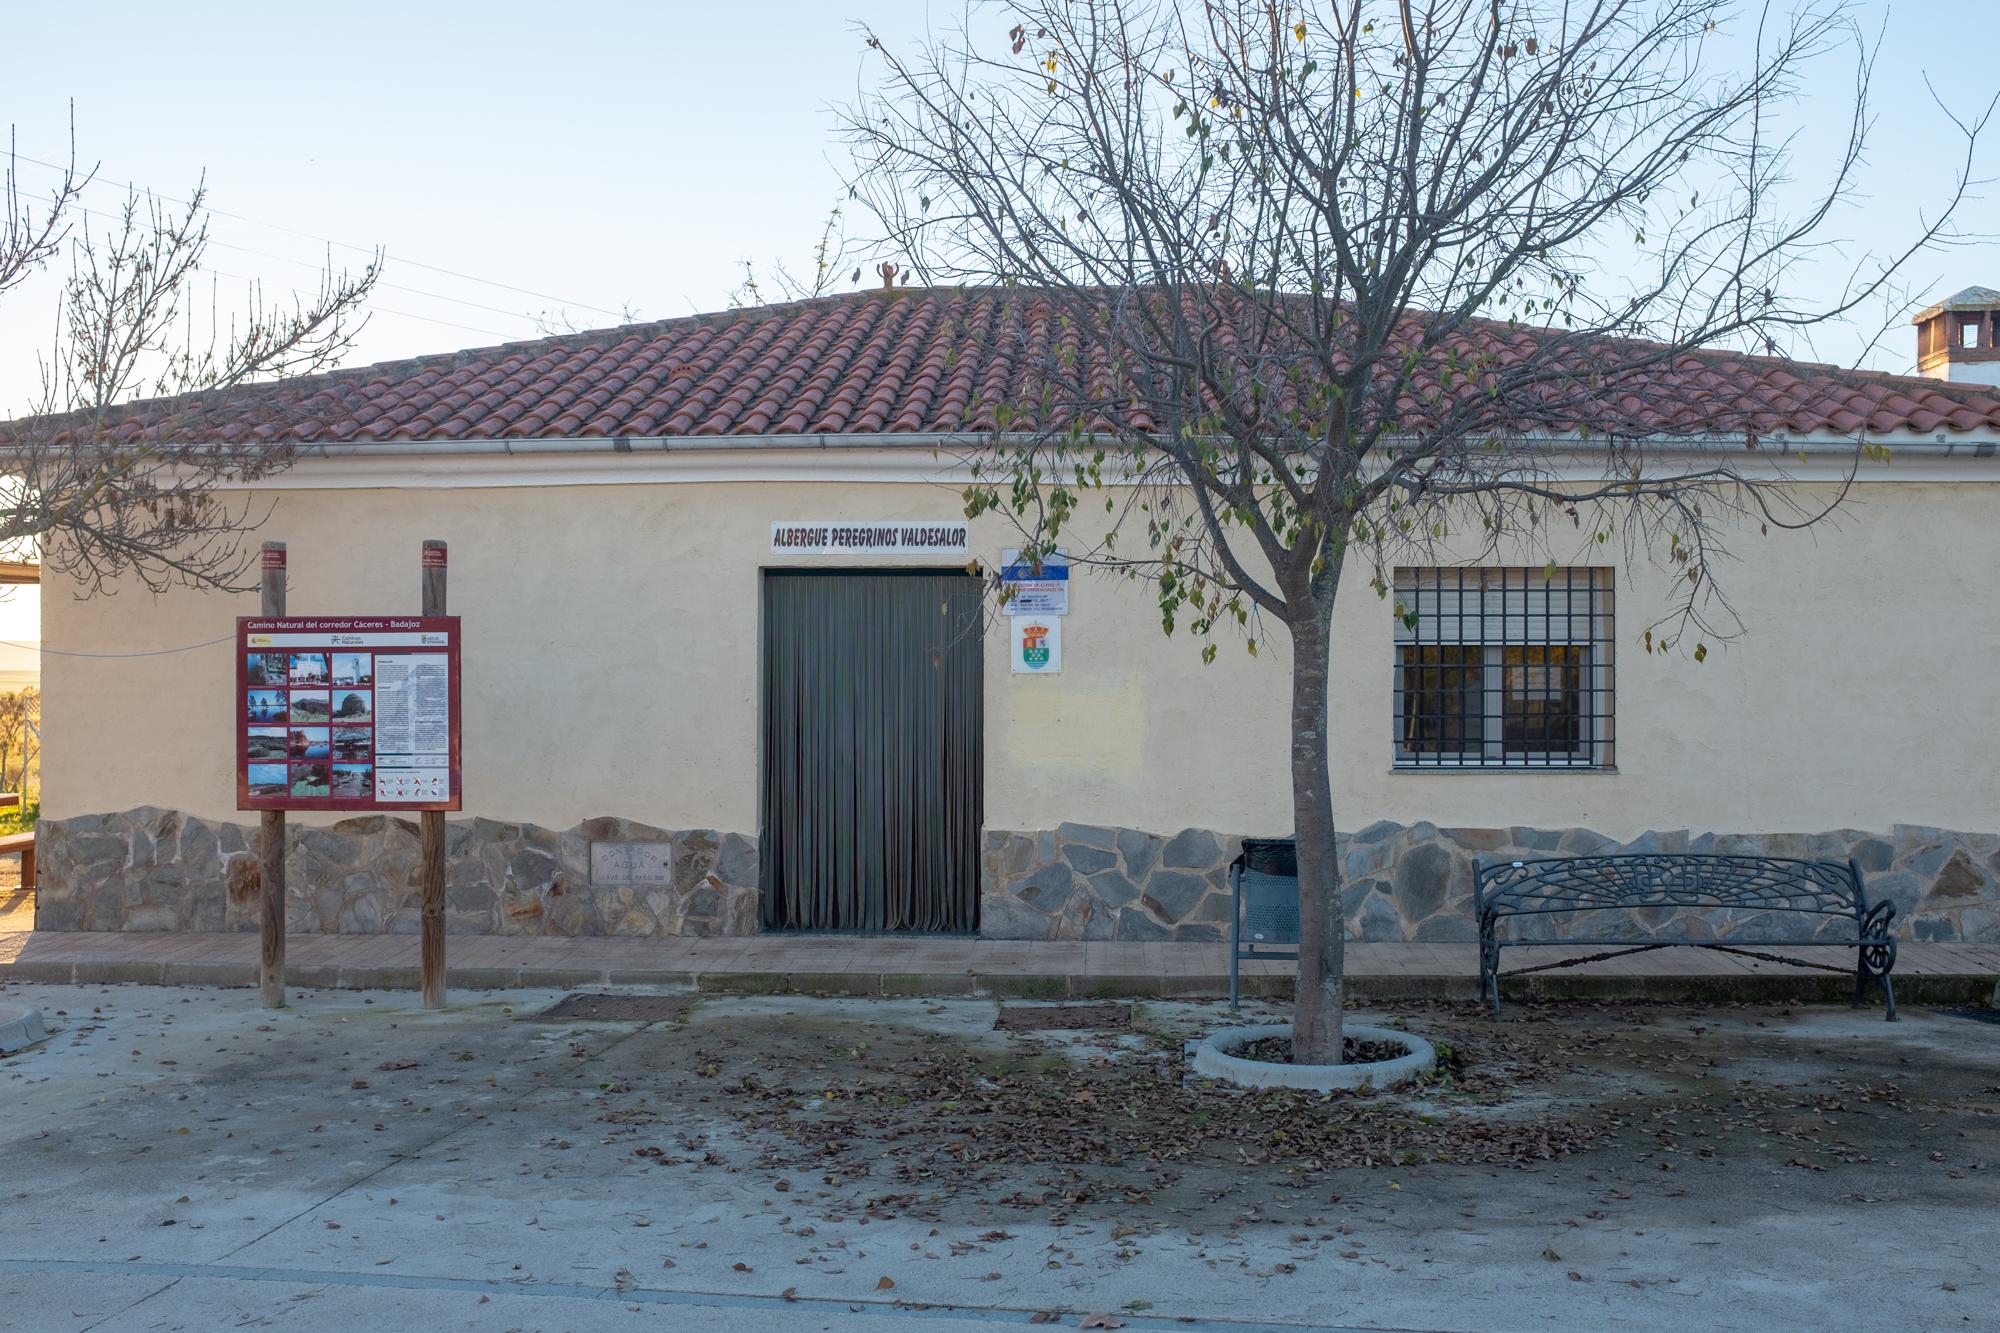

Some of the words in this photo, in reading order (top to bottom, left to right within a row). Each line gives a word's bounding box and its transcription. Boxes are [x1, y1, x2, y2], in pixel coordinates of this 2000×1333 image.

[774, 527, 828, 548] ALBERGUE
[831, 527, 898, 548] PEREGRINOS
[901, 527, 966, 548] VALDESALOR
[247, 621, 275, 629] Camino
[276, 620, 304, 628] Natural
[306, 620, 318, 628] del
[354, 620, 383, 628] Cáceres
[390, 620, 420, 629] Badajoz
